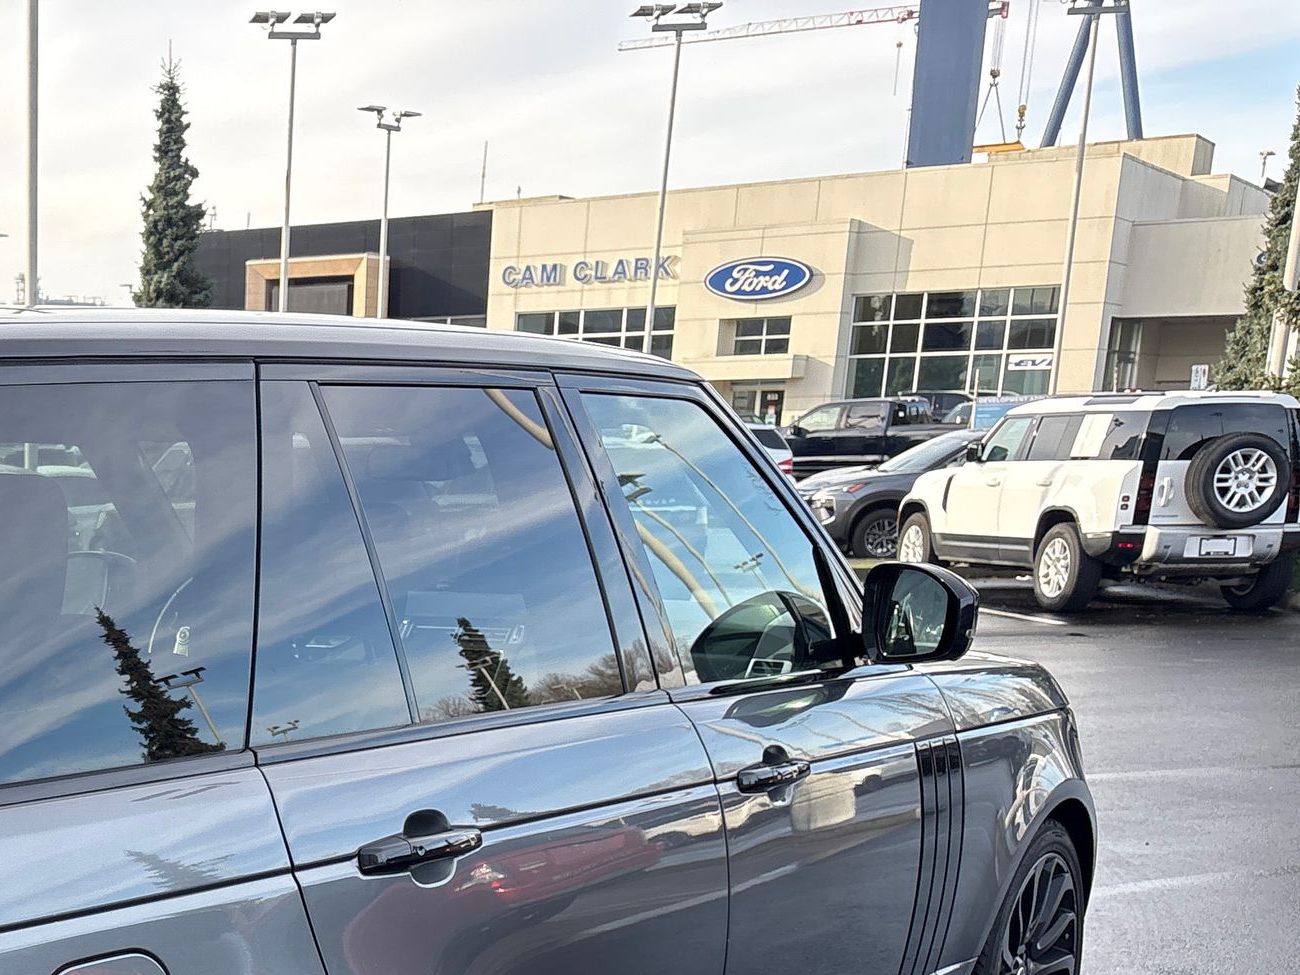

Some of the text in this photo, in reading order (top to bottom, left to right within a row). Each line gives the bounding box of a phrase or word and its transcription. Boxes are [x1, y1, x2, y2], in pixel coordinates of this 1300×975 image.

[502, 255, 677, 288] CAM CLARK
[725, 263, 790, 293] Ford
